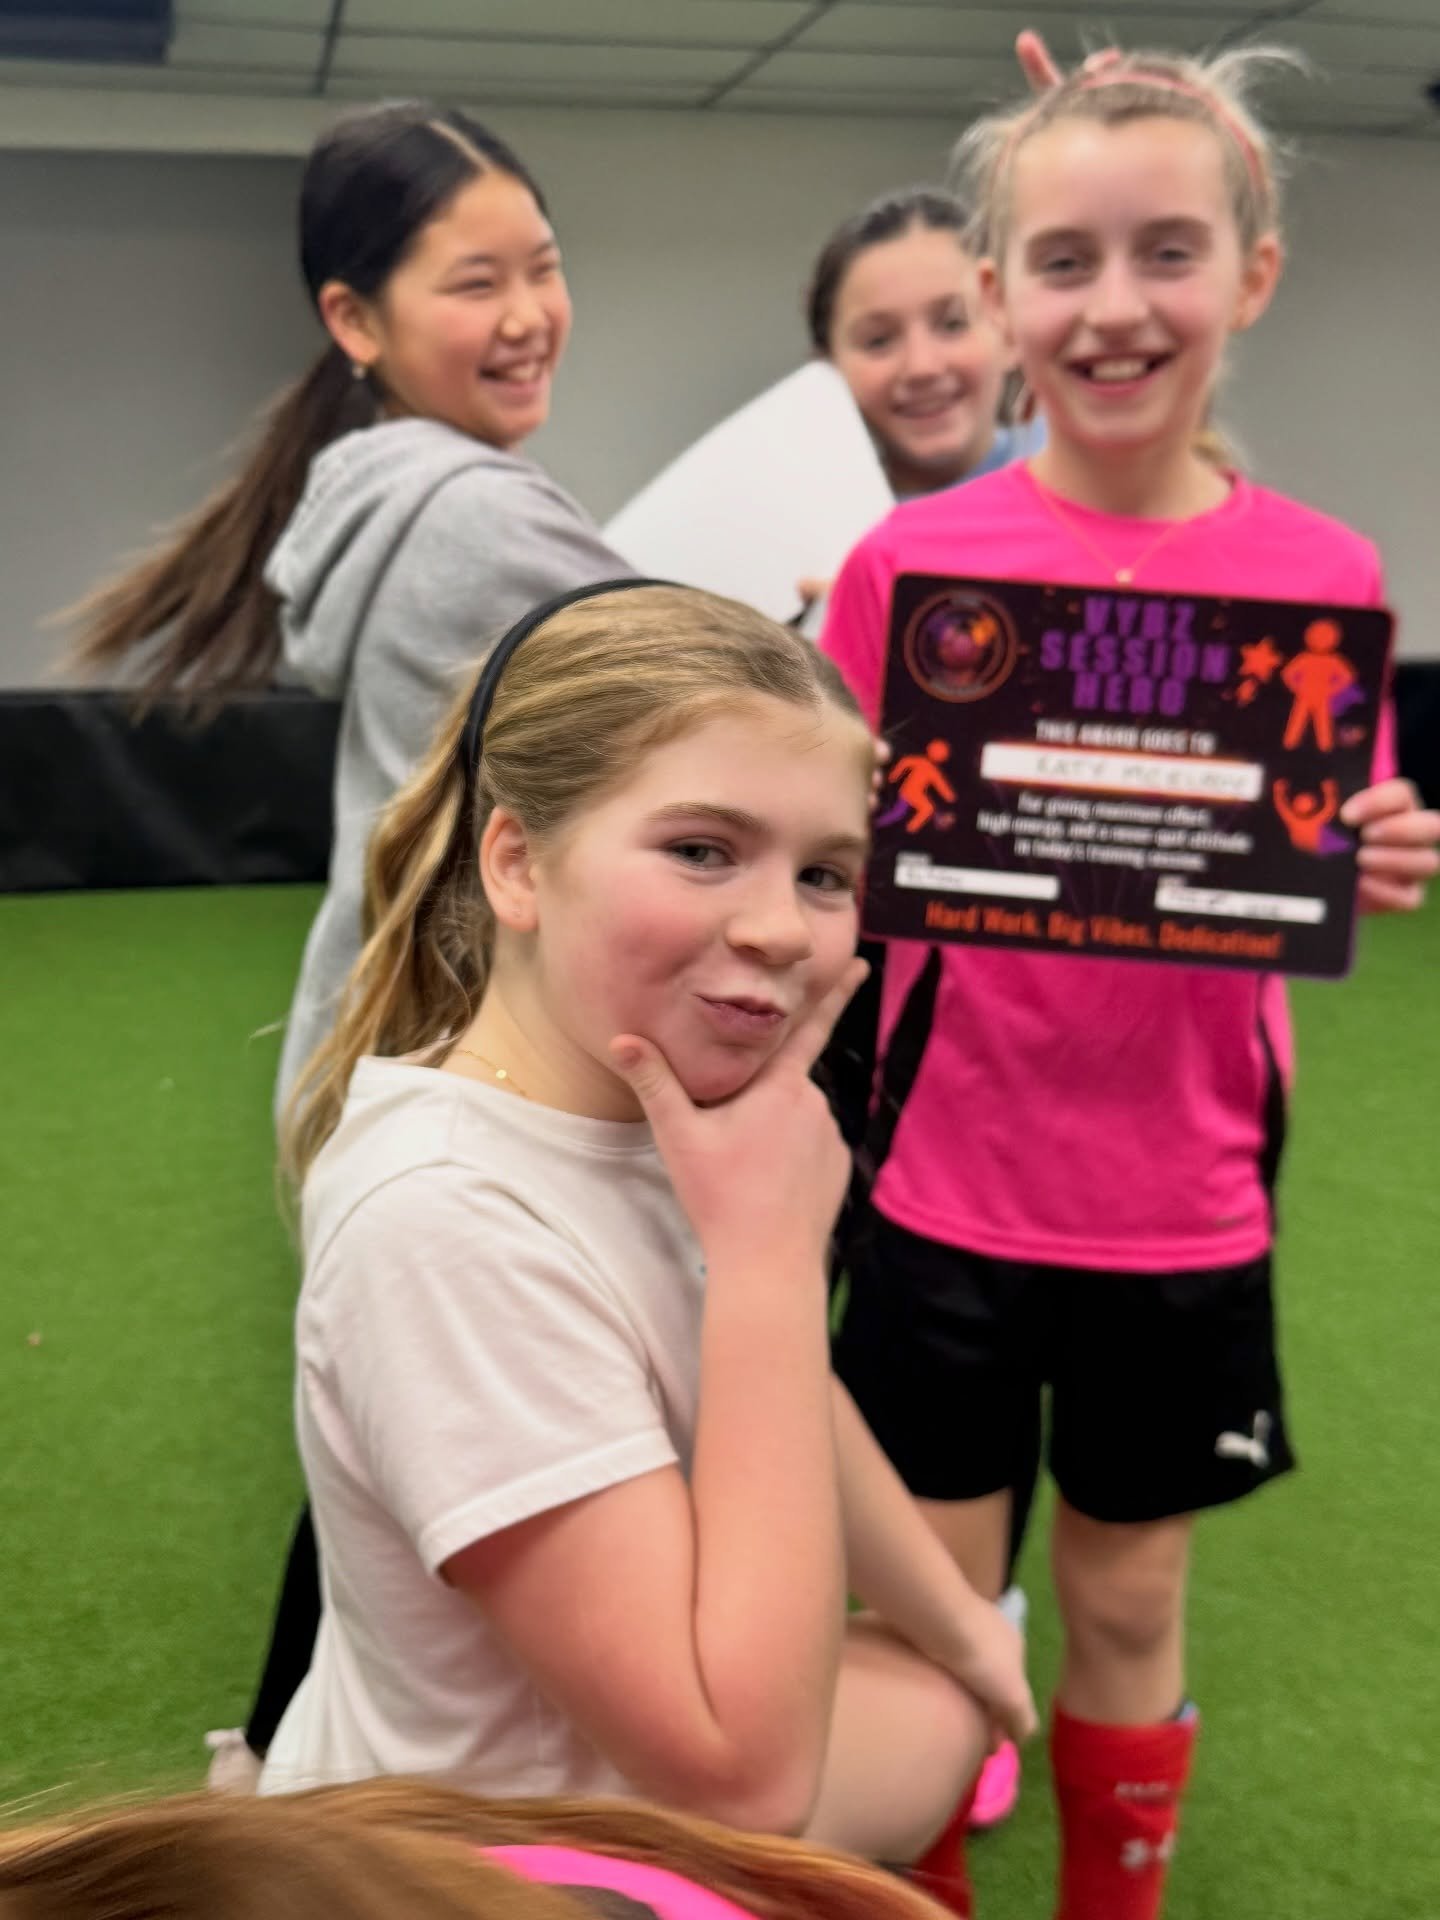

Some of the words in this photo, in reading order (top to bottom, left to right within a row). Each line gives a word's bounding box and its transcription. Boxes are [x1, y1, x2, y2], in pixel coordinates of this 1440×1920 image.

[1040, 630, 1229, 683] SESSION
[1073, 672, 1186, 716] HERO
[1036, 720, 1077, 743] THIS
[1078, 724, 1138, 749] AWARD
[1140, 728, 1188, 753] GOES
[926, 901, 977, 932] Hard
[1047, 911, 1084, 946] Big
